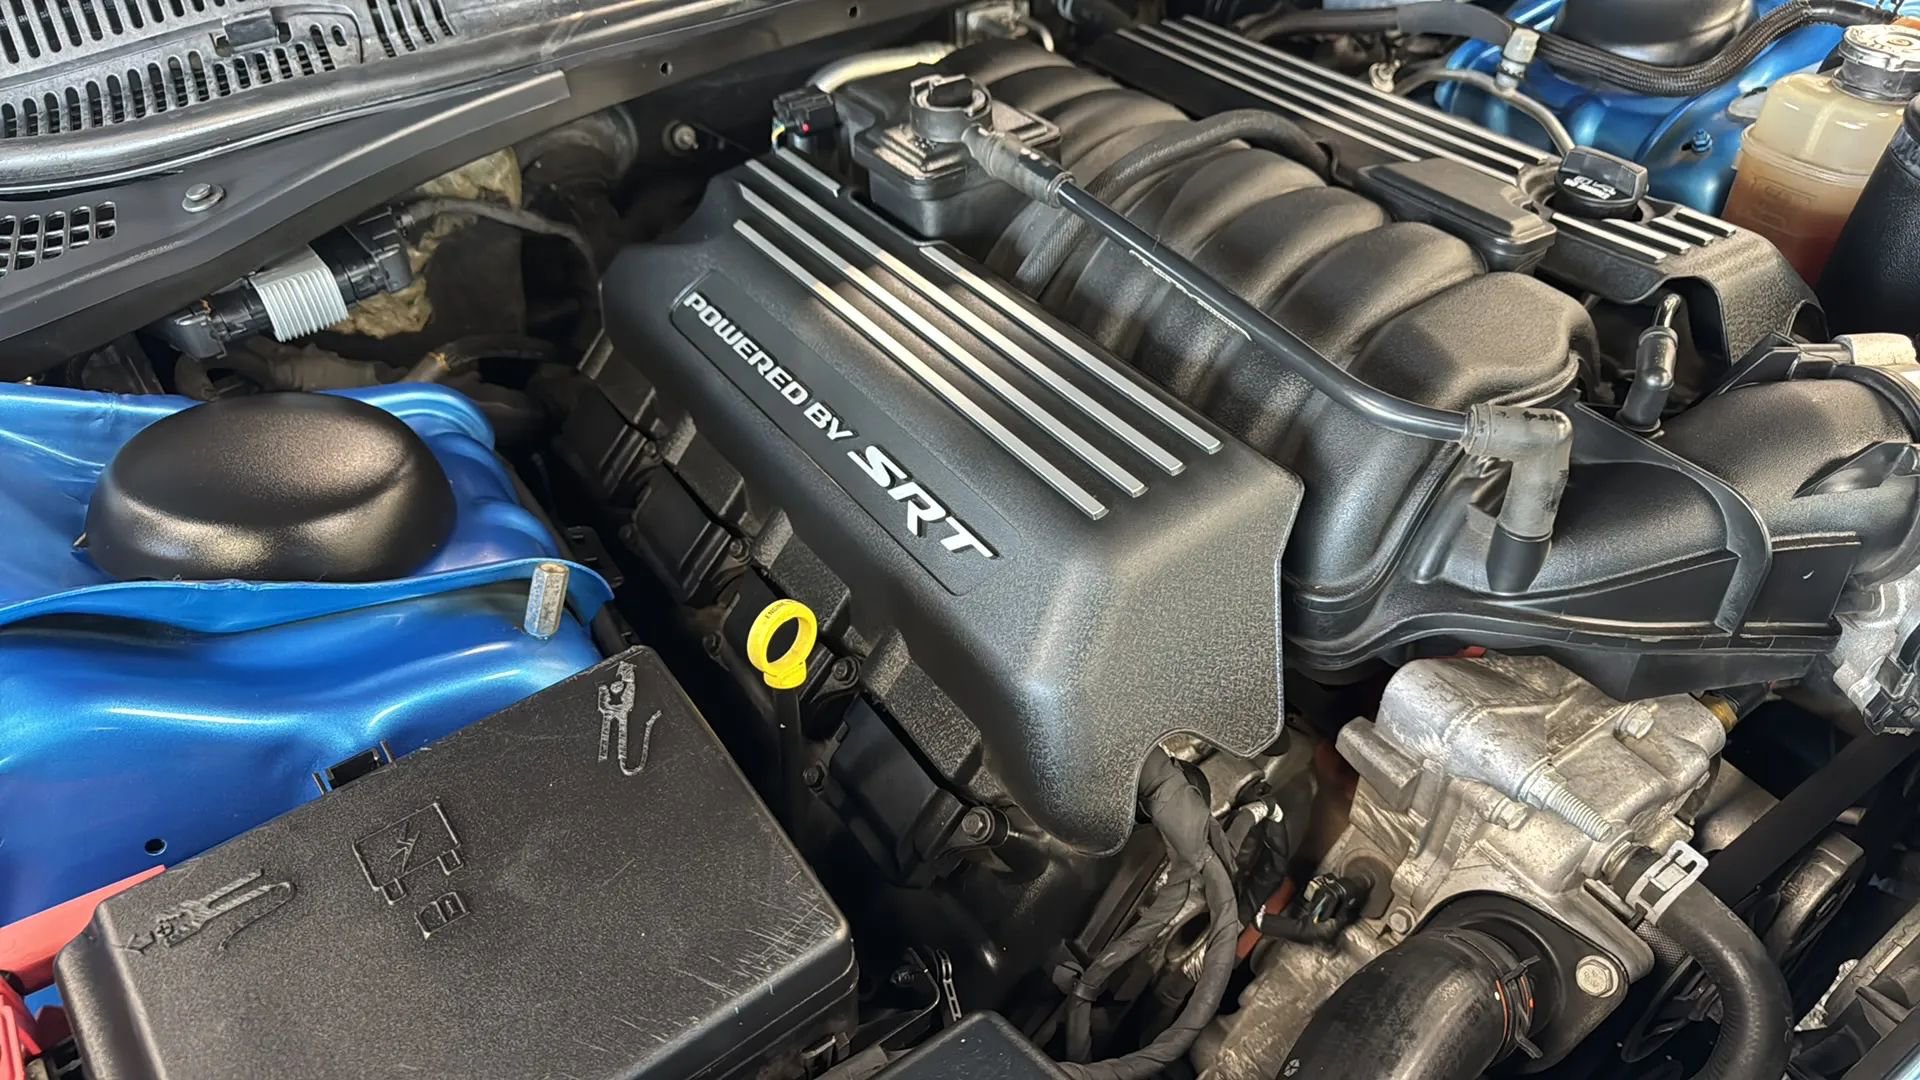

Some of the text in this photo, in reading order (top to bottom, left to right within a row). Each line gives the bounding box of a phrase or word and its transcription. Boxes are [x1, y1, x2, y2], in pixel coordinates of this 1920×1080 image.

[683, 291, 994, 558] POWERED BY SRT
